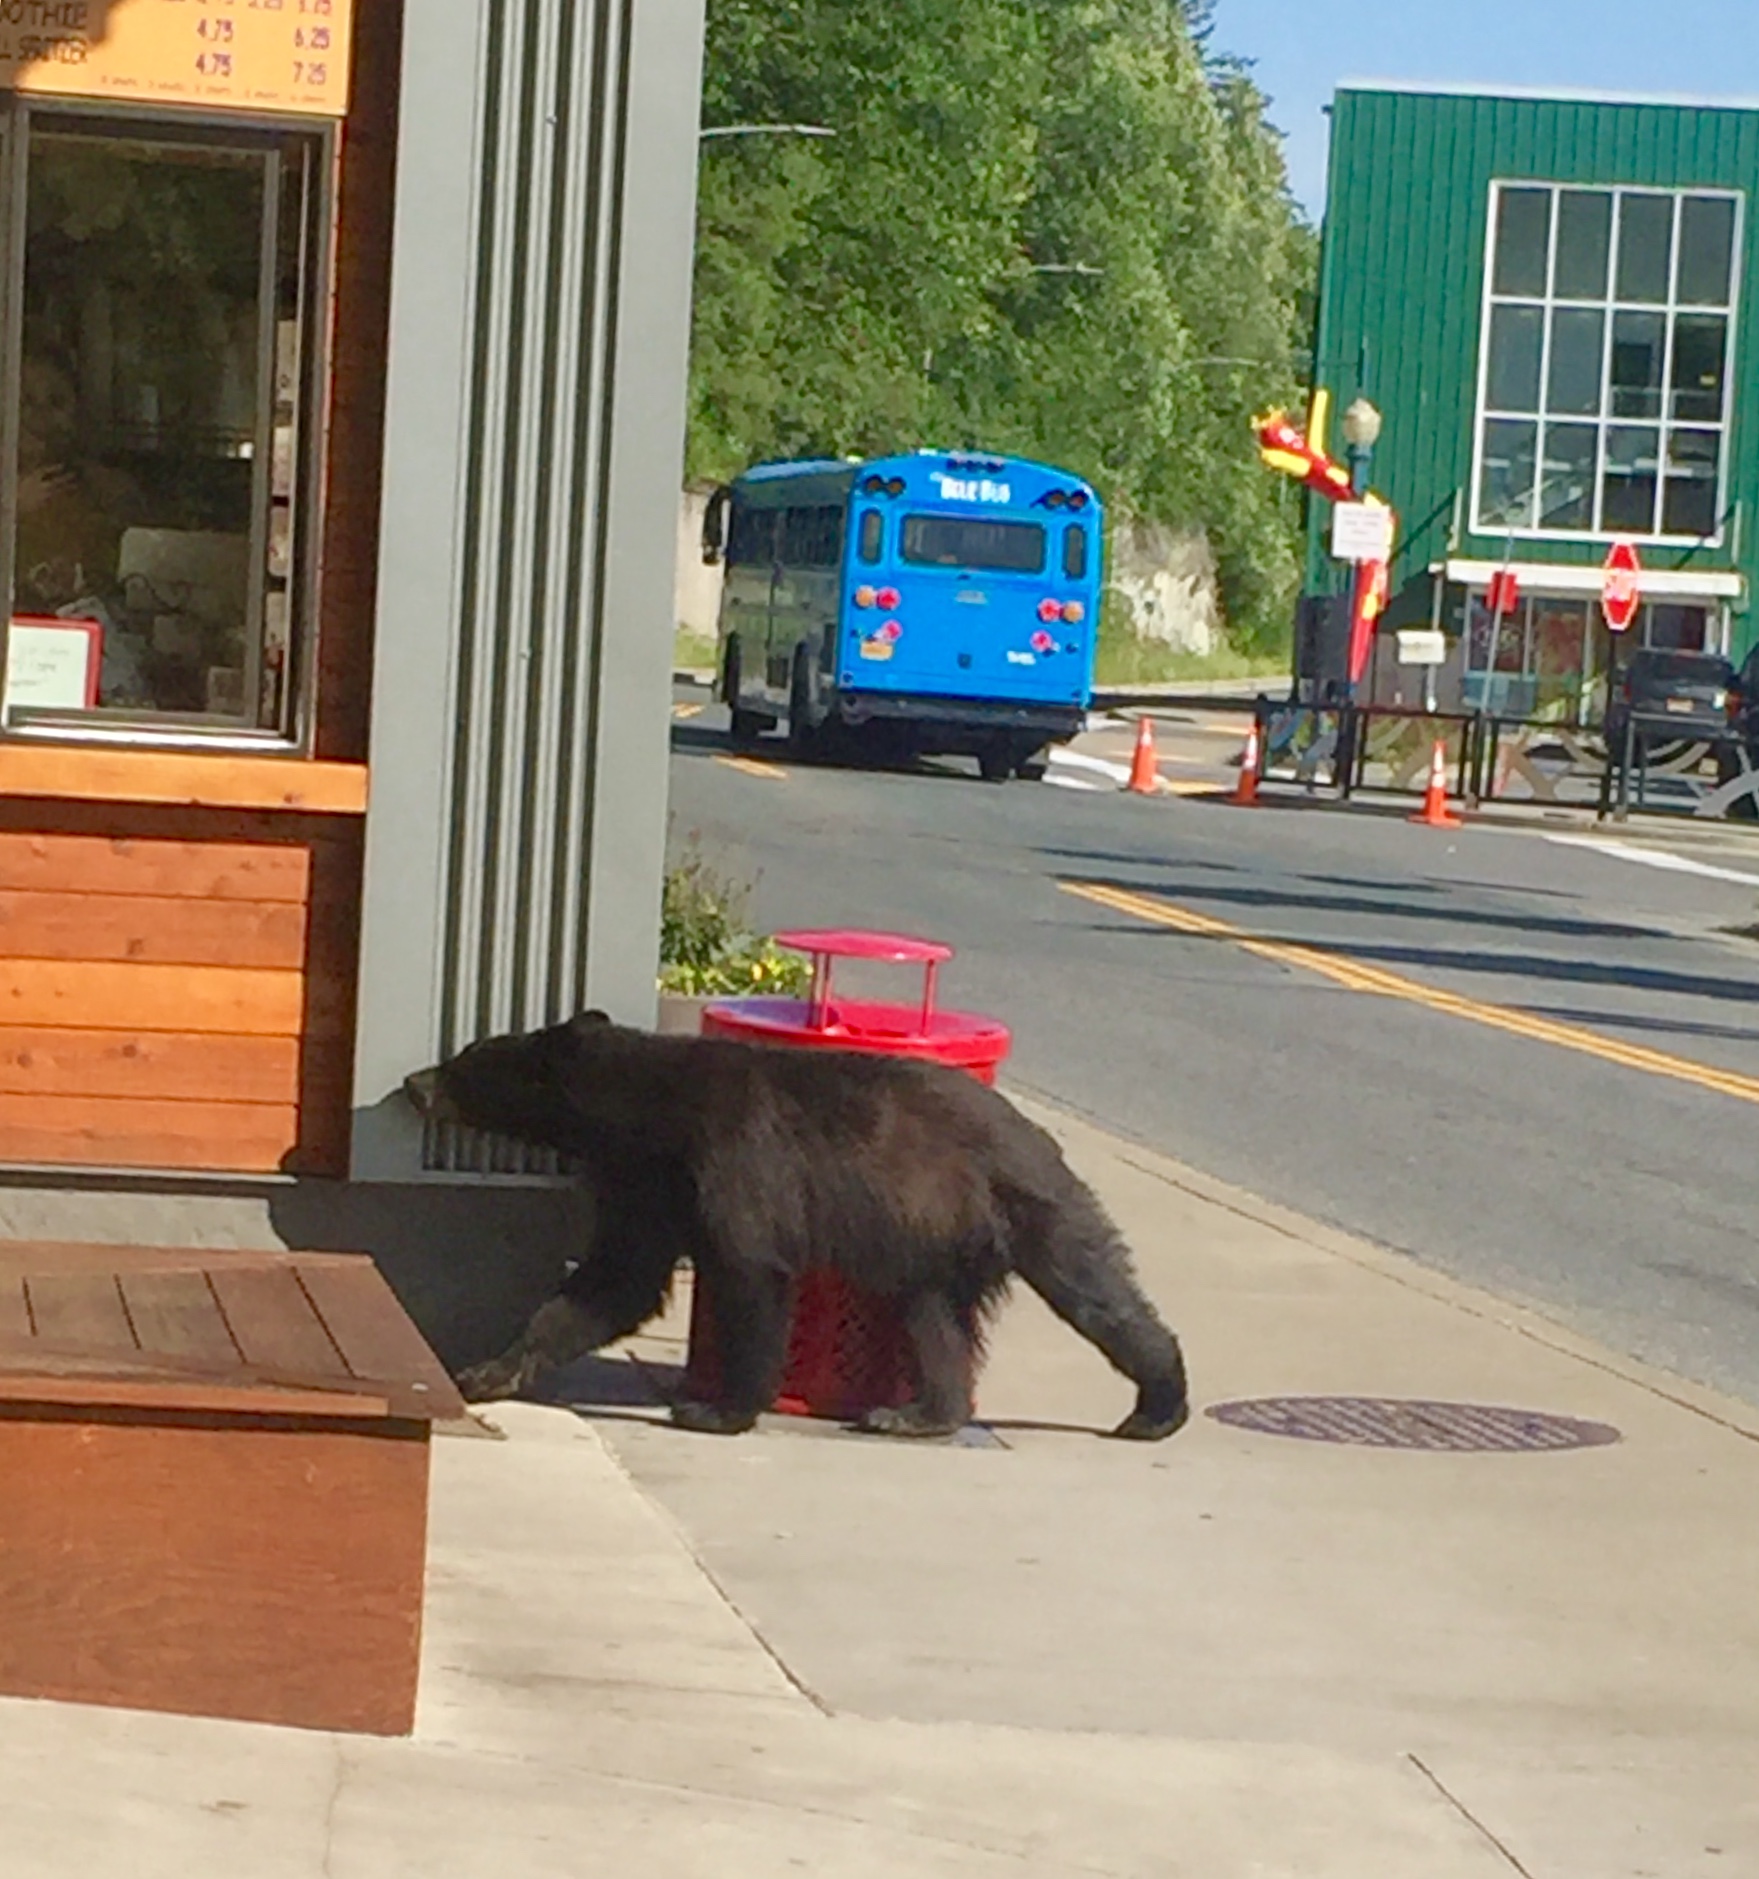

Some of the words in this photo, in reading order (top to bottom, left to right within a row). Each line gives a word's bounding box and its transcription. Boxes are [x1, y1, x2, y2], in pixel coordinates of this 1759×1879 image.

[0, 0, 87, 29] OTHIE
[198, 18, 234, 43] 4.75
[294, 27, 330, 51] 6.25
[196, 53, 231, 78] 4.75
[293, 61, 327, 86] 7.25
